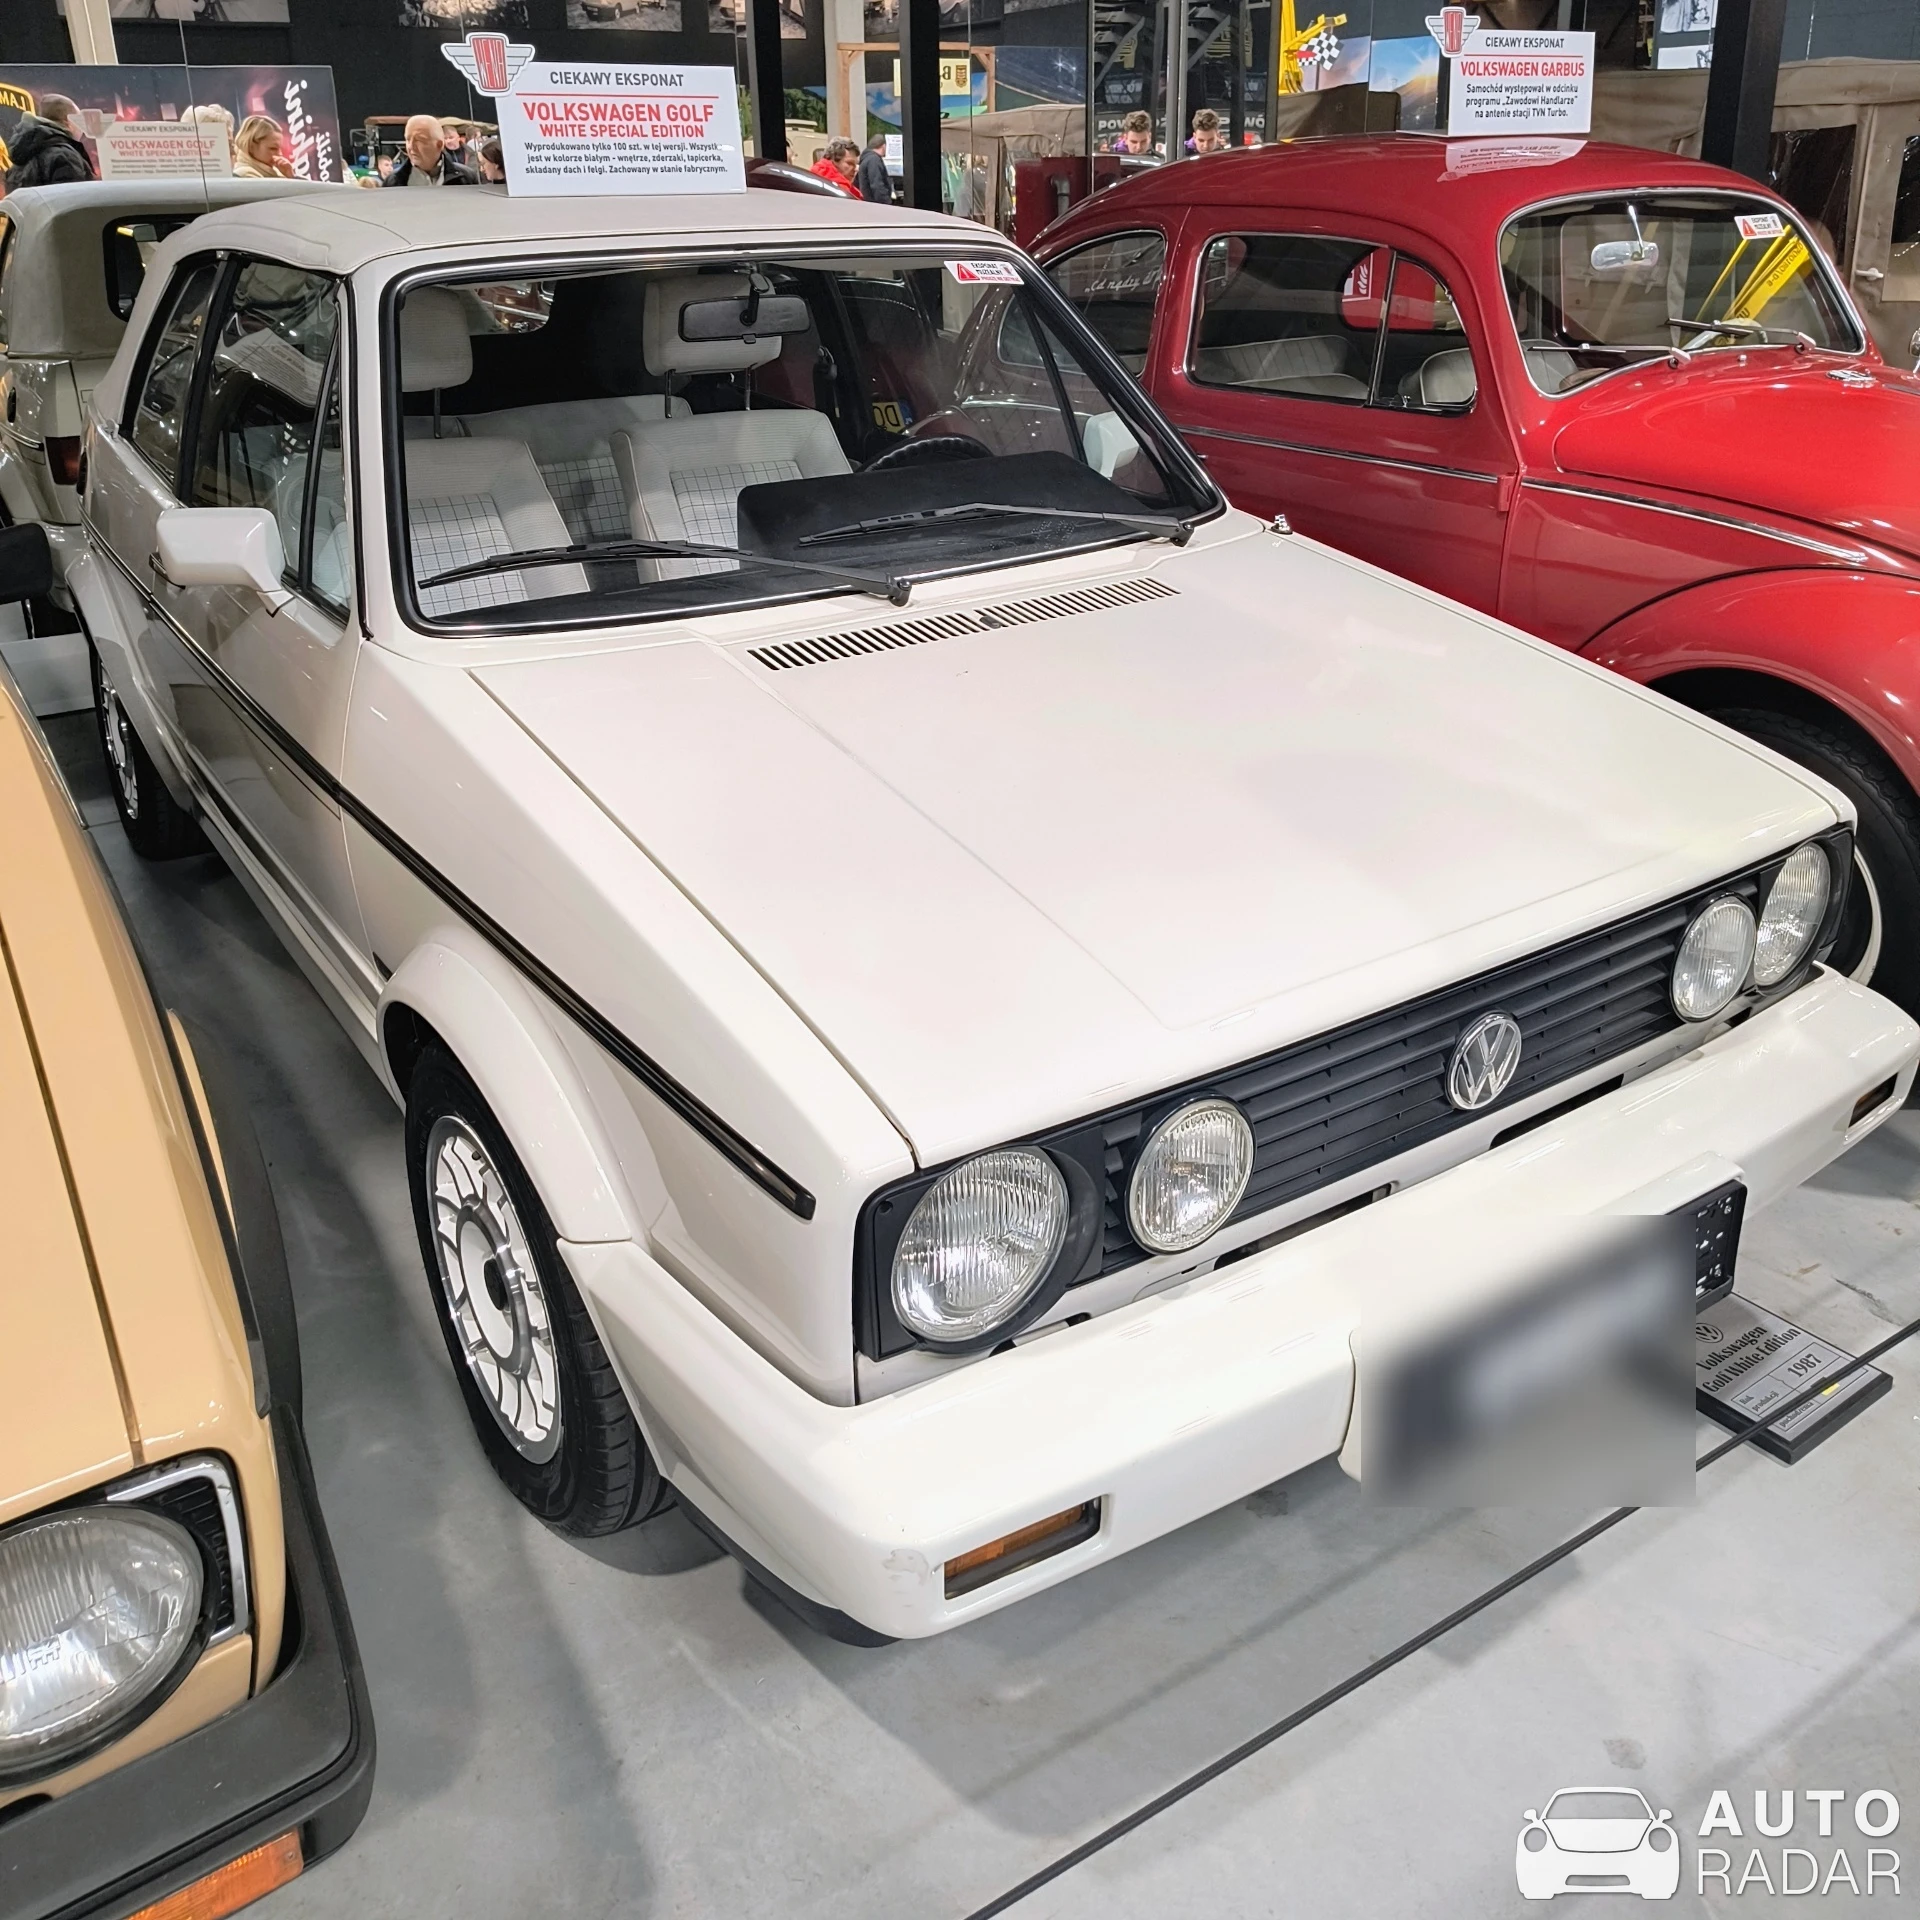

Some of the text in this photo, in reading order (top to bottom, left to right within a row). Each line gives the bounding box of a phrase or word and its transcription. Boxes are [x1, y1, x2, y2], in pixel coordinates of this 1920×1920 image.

[1485, 37, 1565, 48] CIEKAWY EKSPONAT
[1461, 61, 1585, 77] VOLKSWAGEN GARBUS
[550, 71, 684, 87] CIEKAWY EKSPONAT
[1466, 83, 1503, 93] Samochód
[1504, 84, 1544, 96] występował
[1552, 84, 1578, 93] odcinku
[1465, 97, 1501, 108] programu
[1502, 96, 1540, 106] „Zawodowi
[523, 102, 714, 122] VOLKSWAGEN GOLF
[1475, 108, 1568, 120] na antenie stacji TVN Turbo.
[539, 124, 705, 138] WHITE SPECIAL EDITION
[110, 140, 184, 150] VOLKSWAGEN
[524, 142, 591, 152] Wyprodukowano
[592, 142, 612, 152] tylko
[613, 142, 626, 151] 100
[628, 143, 642, 151] szt.
[651, 142, 662, 152] tej
[662, 142, 688, 152] wersji.
[689, 142, 721, 152] Wszystk
[527, 154, 543, 164] jest
[552, 154, 583, 162] kolorze
[584, 154, 611, 164] białym
[617, 154, 651, 164] wnętrze,
[652, 154, 686, 163] zderzaki,
[688, 154, 724, 163] tapicerka,
[526, 166, 561, 175] składany
[563, 166, 582, 174] dach
[588, 165, 608, 175] felgi.
[609, 166, 650, 174] Zachowany
[652, 166, 659, 174] w
[684, 164, 728, 174] fabrycznym.
[1696, 1325, 1768, 1371] Volkswagen
[1702, 1327, 1802, 1393] Golf White Edition
[1787, 1353, 1823, 1378] 1987
